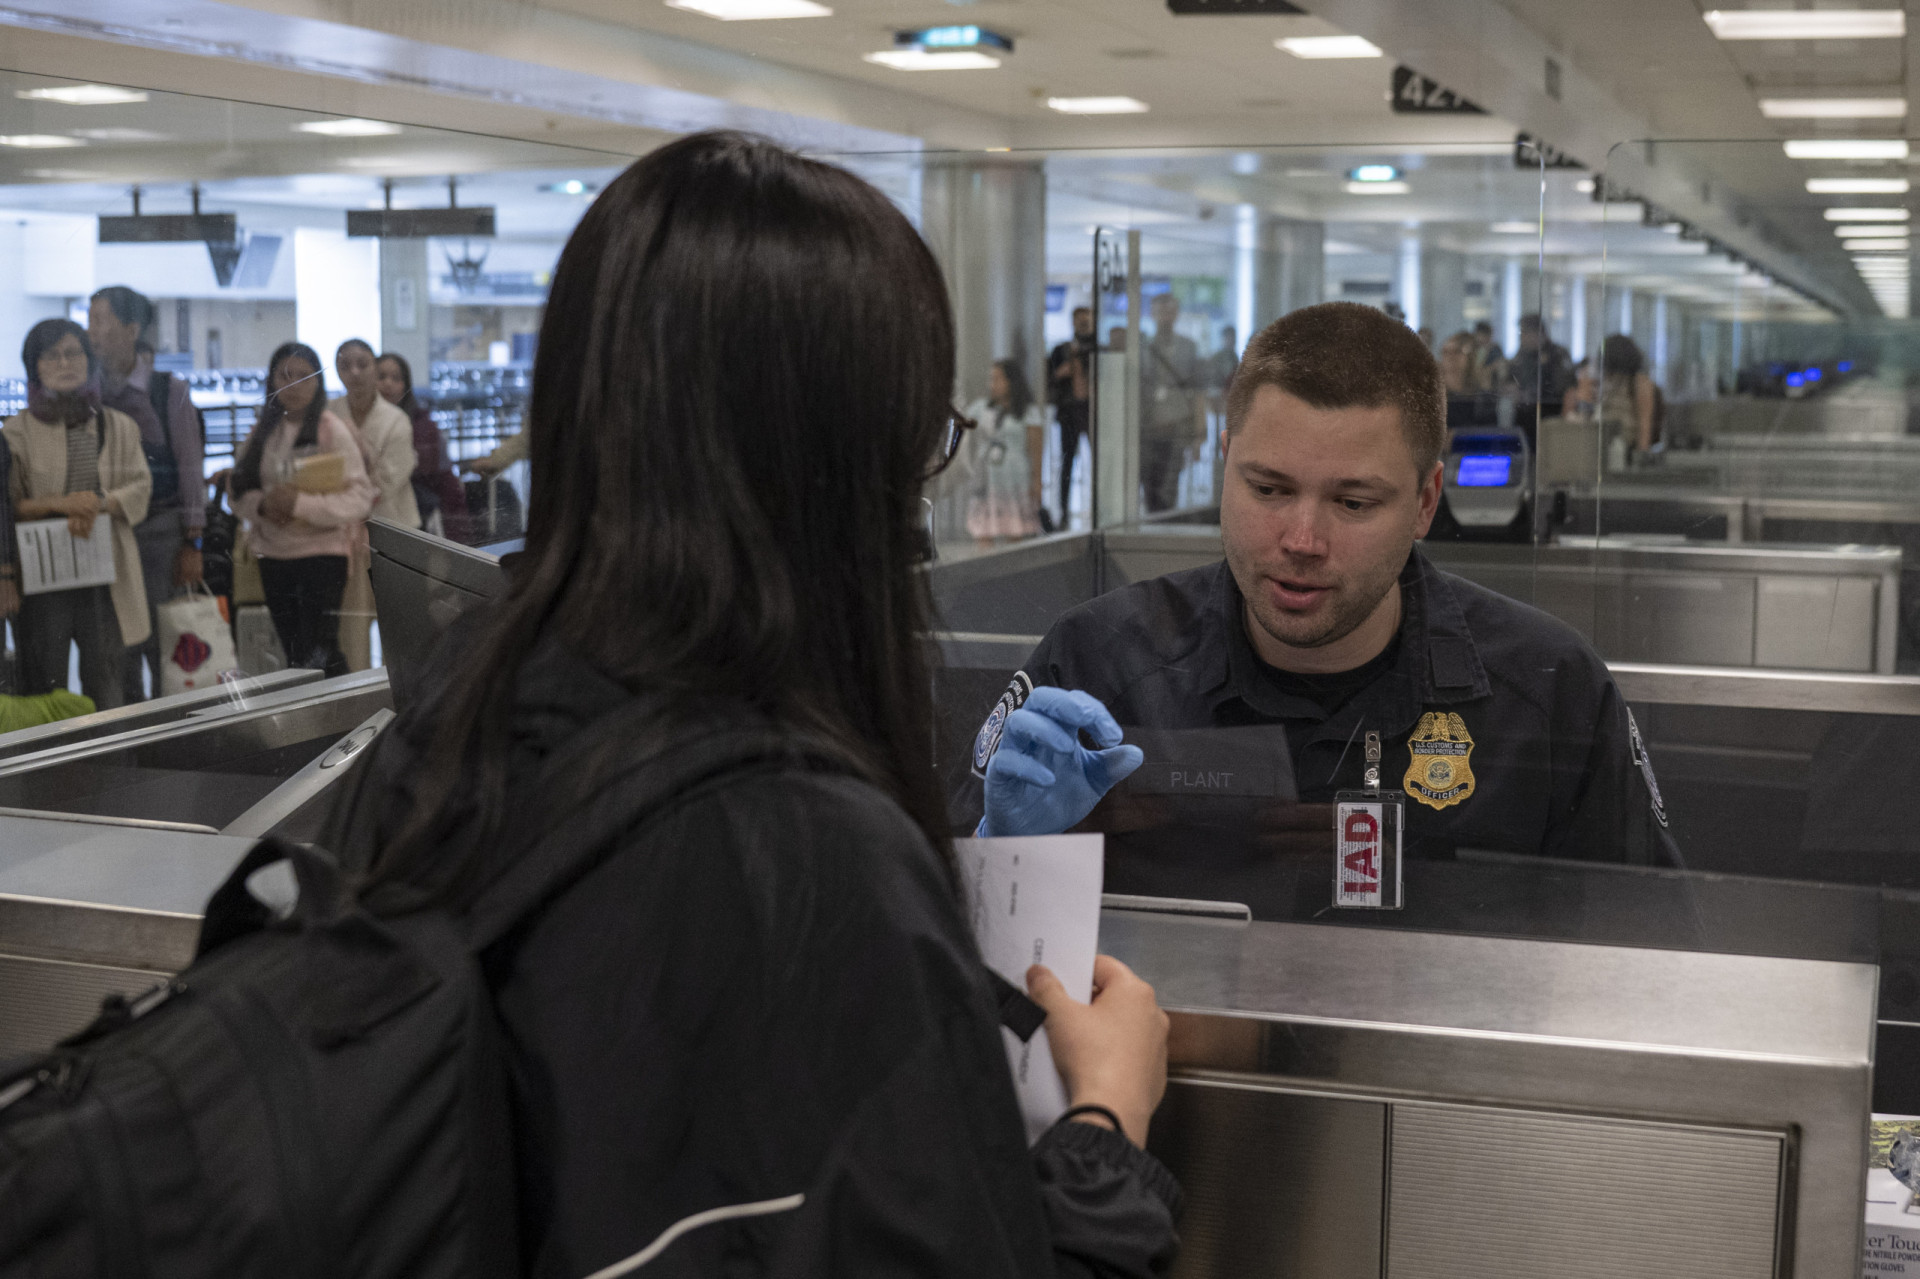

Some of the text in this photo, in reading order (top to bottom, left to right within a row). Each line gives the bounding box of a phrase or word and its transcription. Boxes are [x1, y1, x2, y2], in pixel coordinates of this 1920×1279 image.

[1170, 771, 1234, 788] PLANT
[1421, 786, 1460, 799] OFFICER
[1344, 813, 1378, 893] IAD
[1866, 1236, 1885, 1248] er
[1873, 1250, 1897, 1260] NITRILE
[1880, 1262, 1906, 1272] GLOVES
